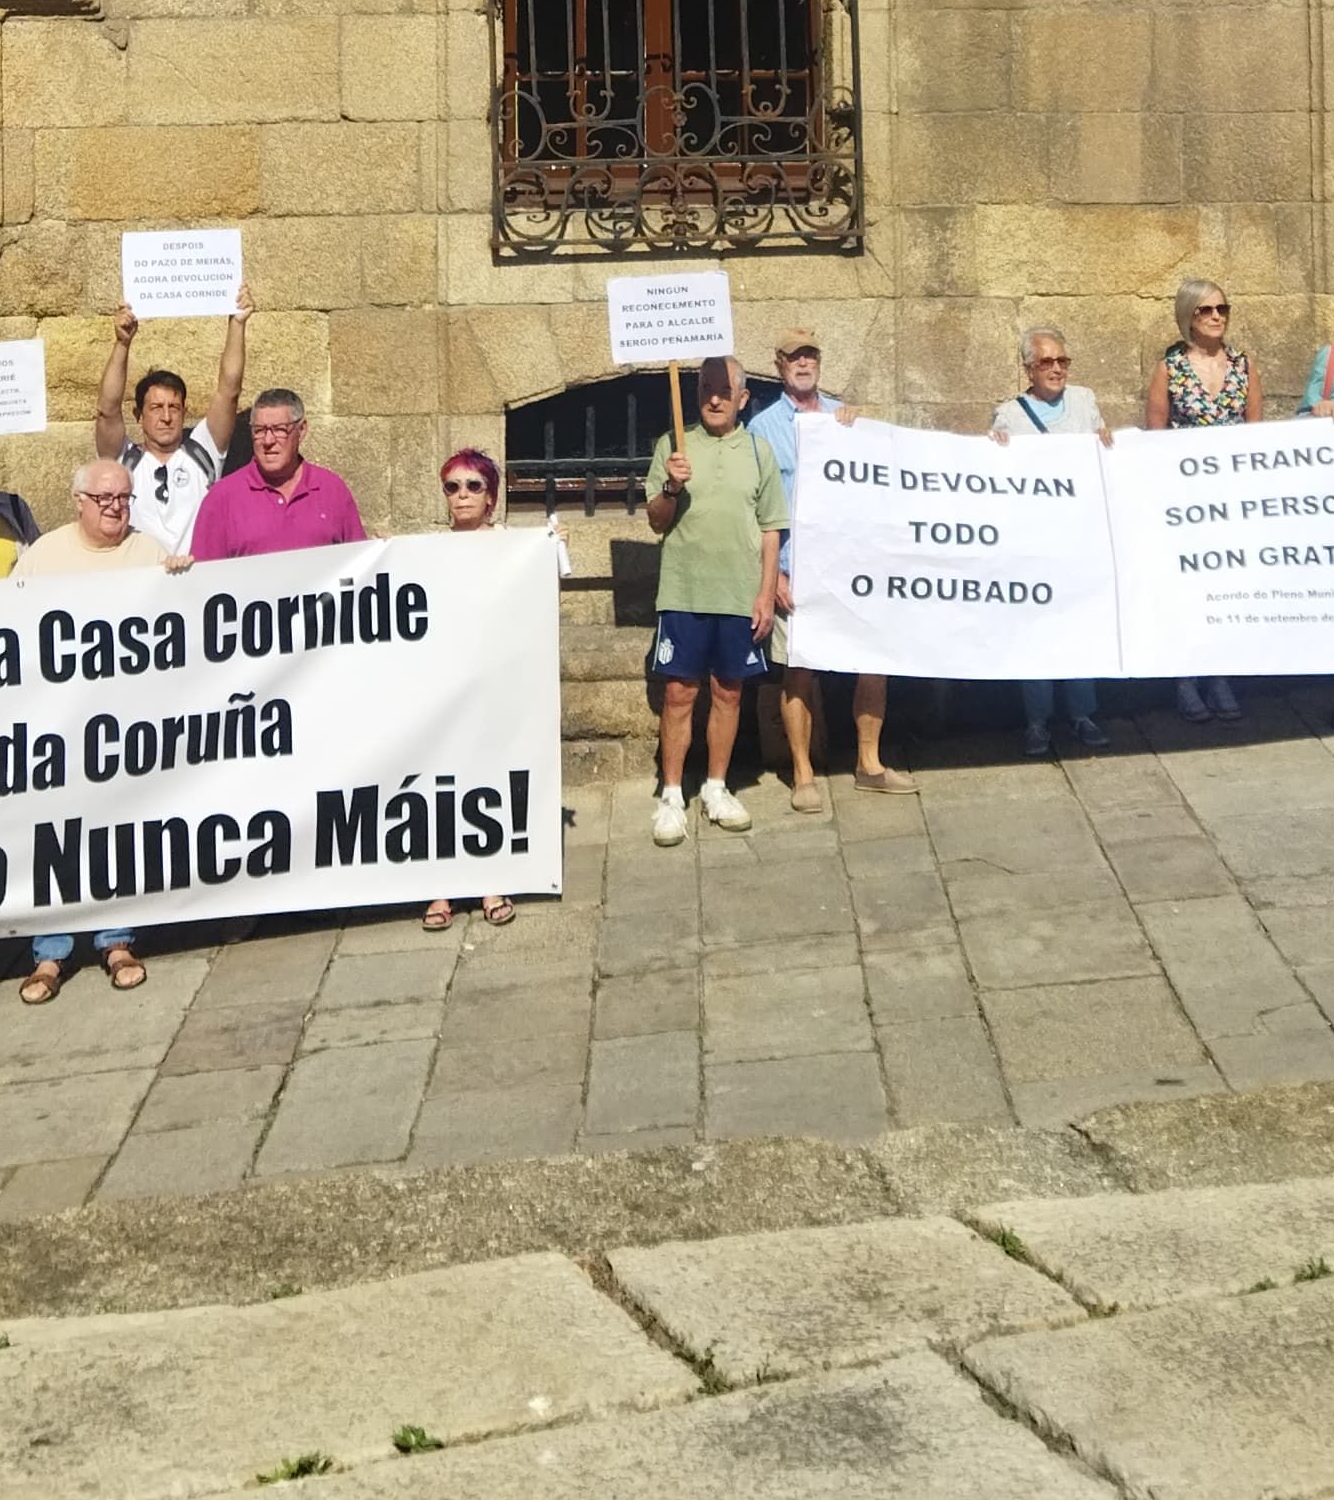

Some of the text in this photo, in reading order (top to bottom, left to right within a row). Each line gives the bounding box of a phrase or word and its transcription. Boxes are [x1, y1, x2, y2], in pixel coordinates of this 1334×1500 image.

[163, 242, 204, 251] DESPOIS
[134, 260, 148, 268] DO
[151, 259, 178, 267] PAZO
[180, 258, 193, 266] DE
[133, 272, 233, 284] AGORA DEVOLUCIÓN
[139, 289, 227, 300] DA CASA CORNIDE
[625, 316, 715, 330] PARA O ALCALDE
[619, 338, 659, 348] SERGIO
[1179, 456, 1220, 477] OS
[823, 458, 1076, 498] QUE DEVOLVAN
[1165, 502, 1229, 527] SON
[909, 520, 999, 546] TODO
[1179, 548, 1246, 573] NON
[850, 574, 1054, 606] O ROUBADO
[1206, 591, 1250, 602] Acordo
[1253, 590, 1268, 600] do
[1272, 588, 1304, 600] Pleno
[38, 608, 186, 685] Casa
[202, 573, 429, 663] Cornide
[1206, 615, 1223, 625] De
[1226, 614, 1241, 624] 11
[1245, 613, 1260, 623] de
[1263, 613, 1318, 623] setembro
[83, 691, 293, 783] Coruña
[33, 809, 292, 908] Nunca
[314, 770, 530, 869] Máis!
